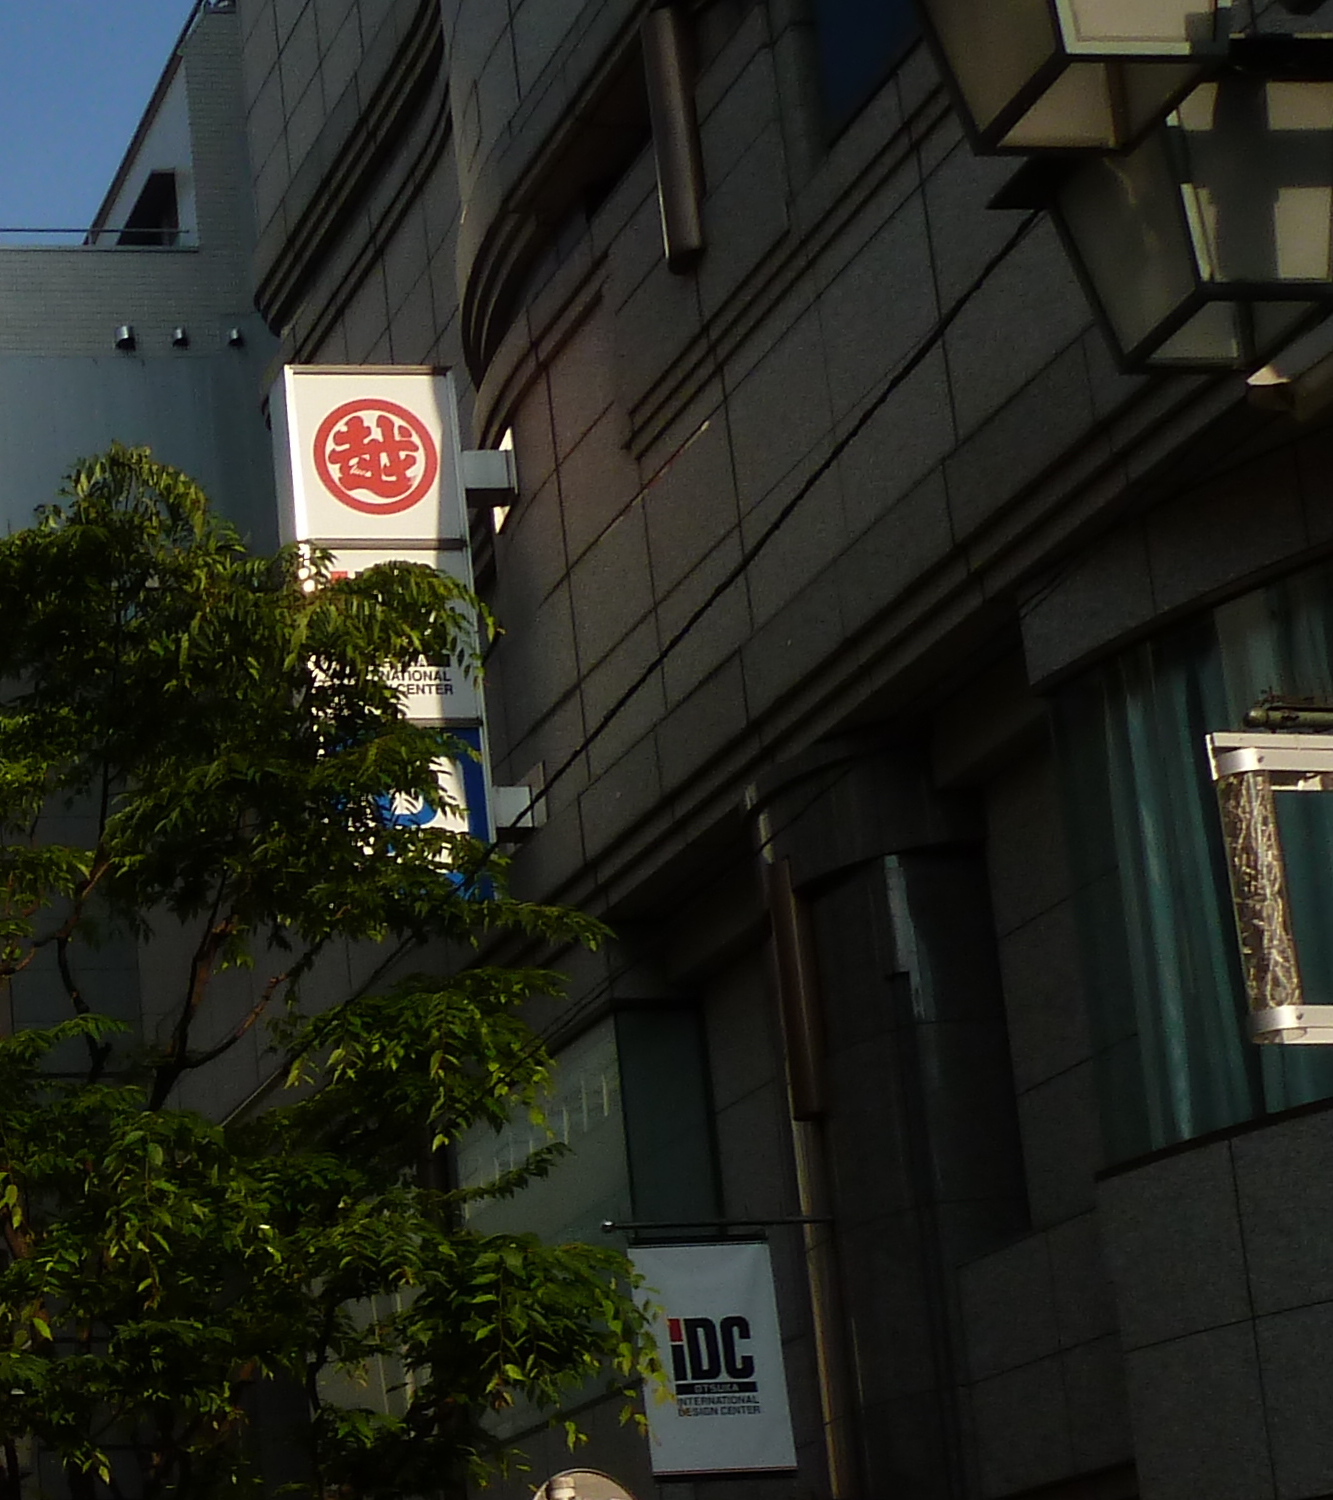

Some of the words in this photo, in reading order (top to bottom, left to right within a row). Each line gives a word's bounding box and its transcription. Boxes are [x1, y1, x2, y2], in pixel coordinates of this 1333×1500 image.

[677, 1395, 760, 1406] INTERNATIONAL
[678, 1406, 719, 1417] DESIGN
[720, 1406, 761, 1416] CENTER
